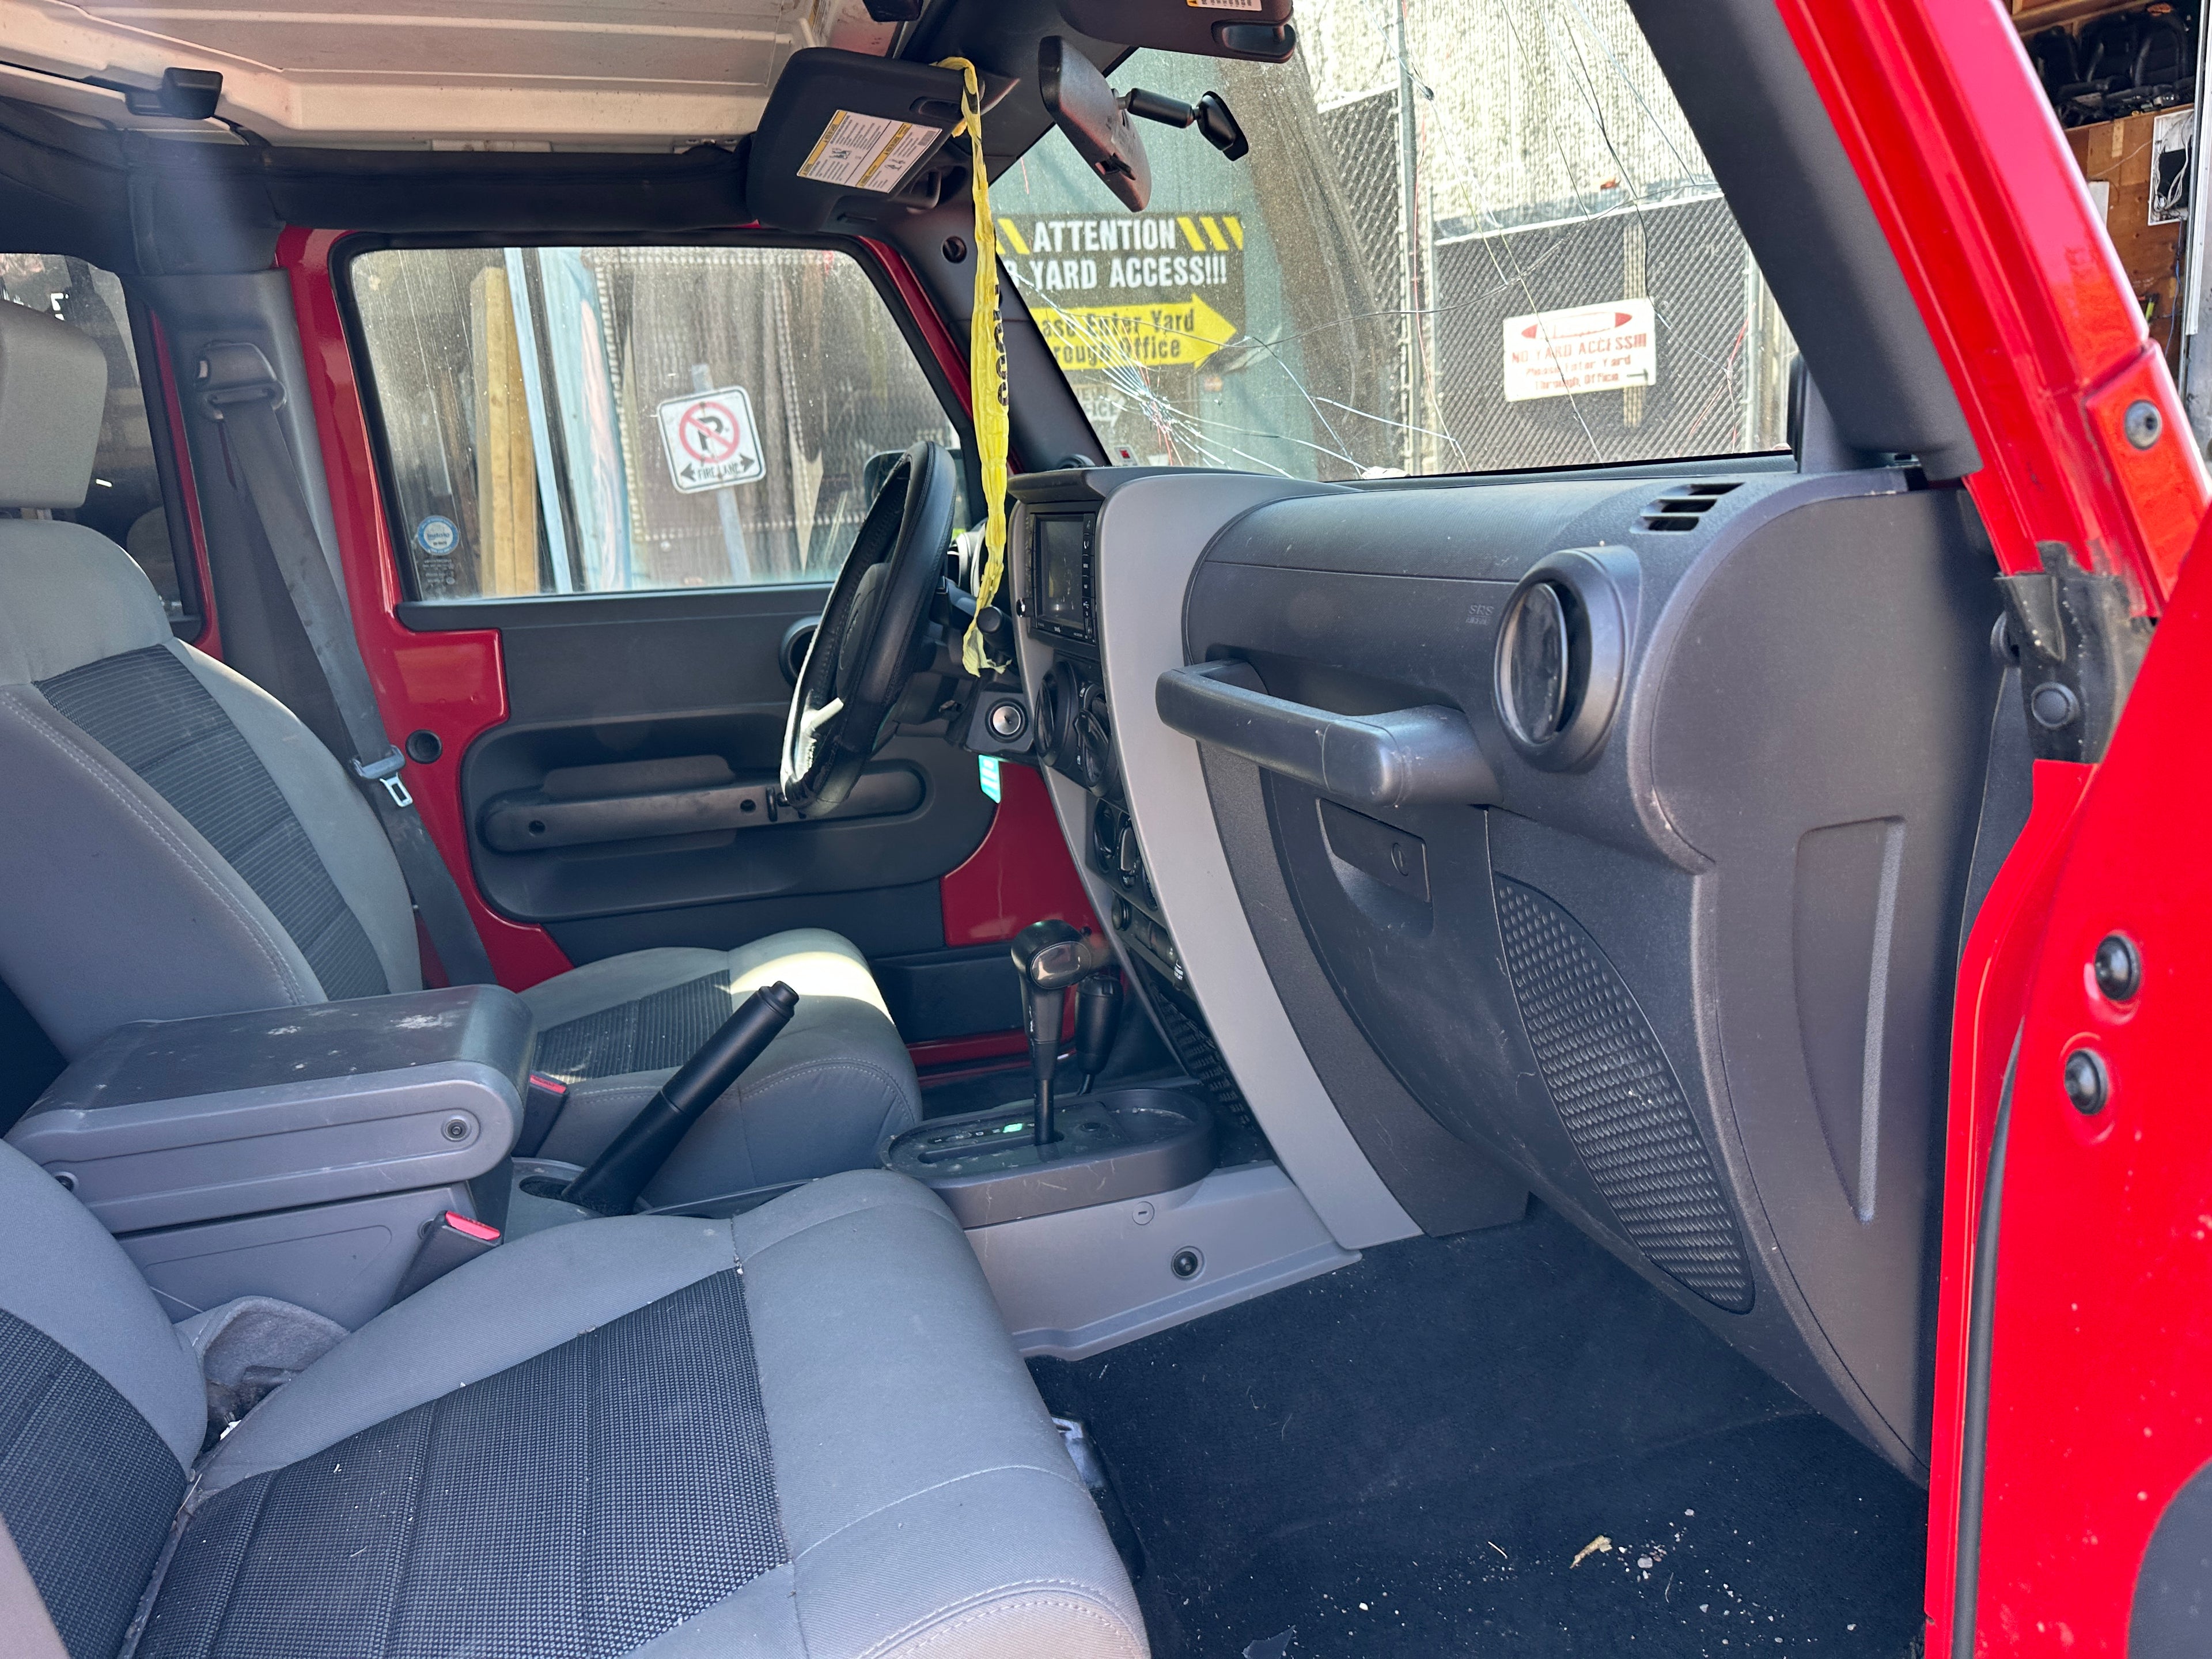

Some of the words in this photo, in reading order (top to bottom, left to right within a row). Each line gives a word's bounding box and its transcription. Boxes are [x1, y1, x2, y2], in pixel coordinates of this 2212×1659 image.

[1033, 218, 1176, 253] ATTENTION
[1030, 257, 1097, 290] YARD
[1109, 255, 1228, 288] ACCESS!!!
[1041, 317, 1075, 339] ase
[1088, 312, 1141, 338] Enter
[1152, 308, 1195, 334] Yard
[1054, 340, 1110, 366] rough
[1121, 335, 1180, 360] Office
[1512, 350, 1528, 363] NO
[1535, 344, 1572, 360] YARD
[1602, 354, 1631, 369] Yard
[1584, 373, 1619, 385] Office
[697, 465, 715, 480] FIRE
[717, 462, 740, 478] LANE
[1468, 604, 1495, 616] SRS
